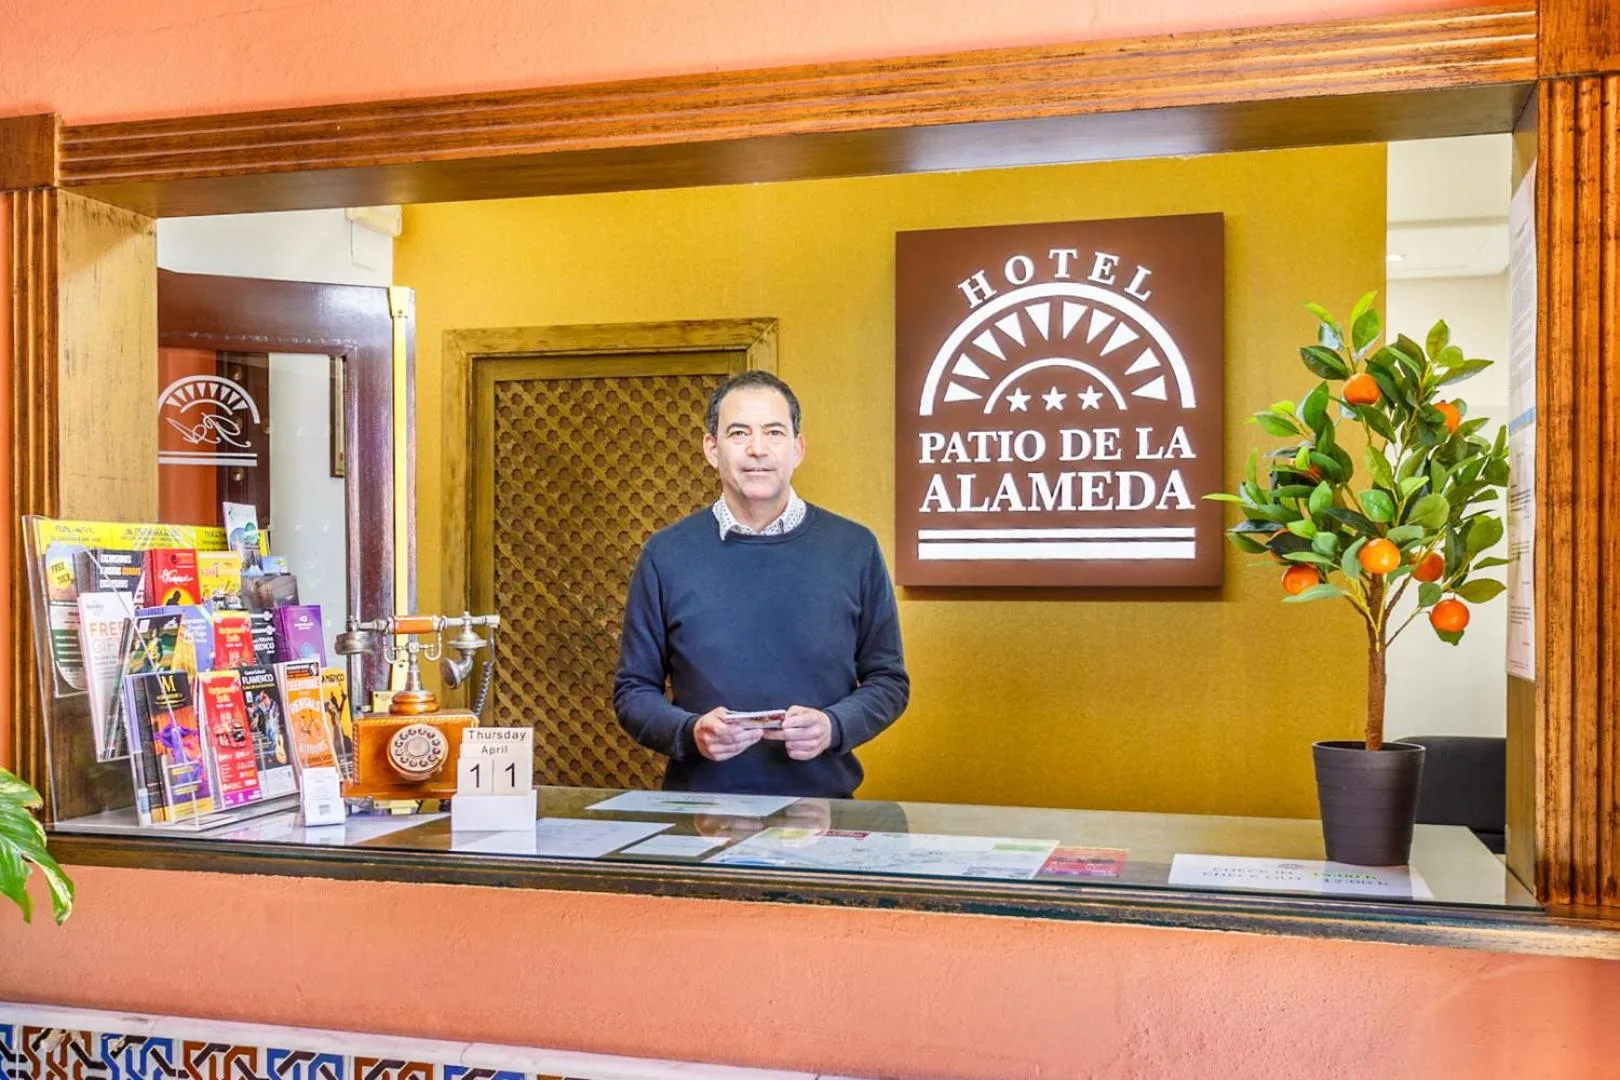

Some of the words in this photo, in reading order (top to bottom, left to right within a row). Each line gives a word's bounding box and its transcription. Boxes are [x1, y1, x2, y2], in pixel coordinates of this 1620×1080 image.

[957, 248, 1153, 309] HOTEL
[918, 430, 1046, 464] PATIO
[1059, 428, 1122, 461] DE
[1135, 426, 1196, 460] LA
[918, 469, 1196, 513] ALAMEDA
[468, 729, 526, 741] Thursday
[481, 745, 508, 756] April
